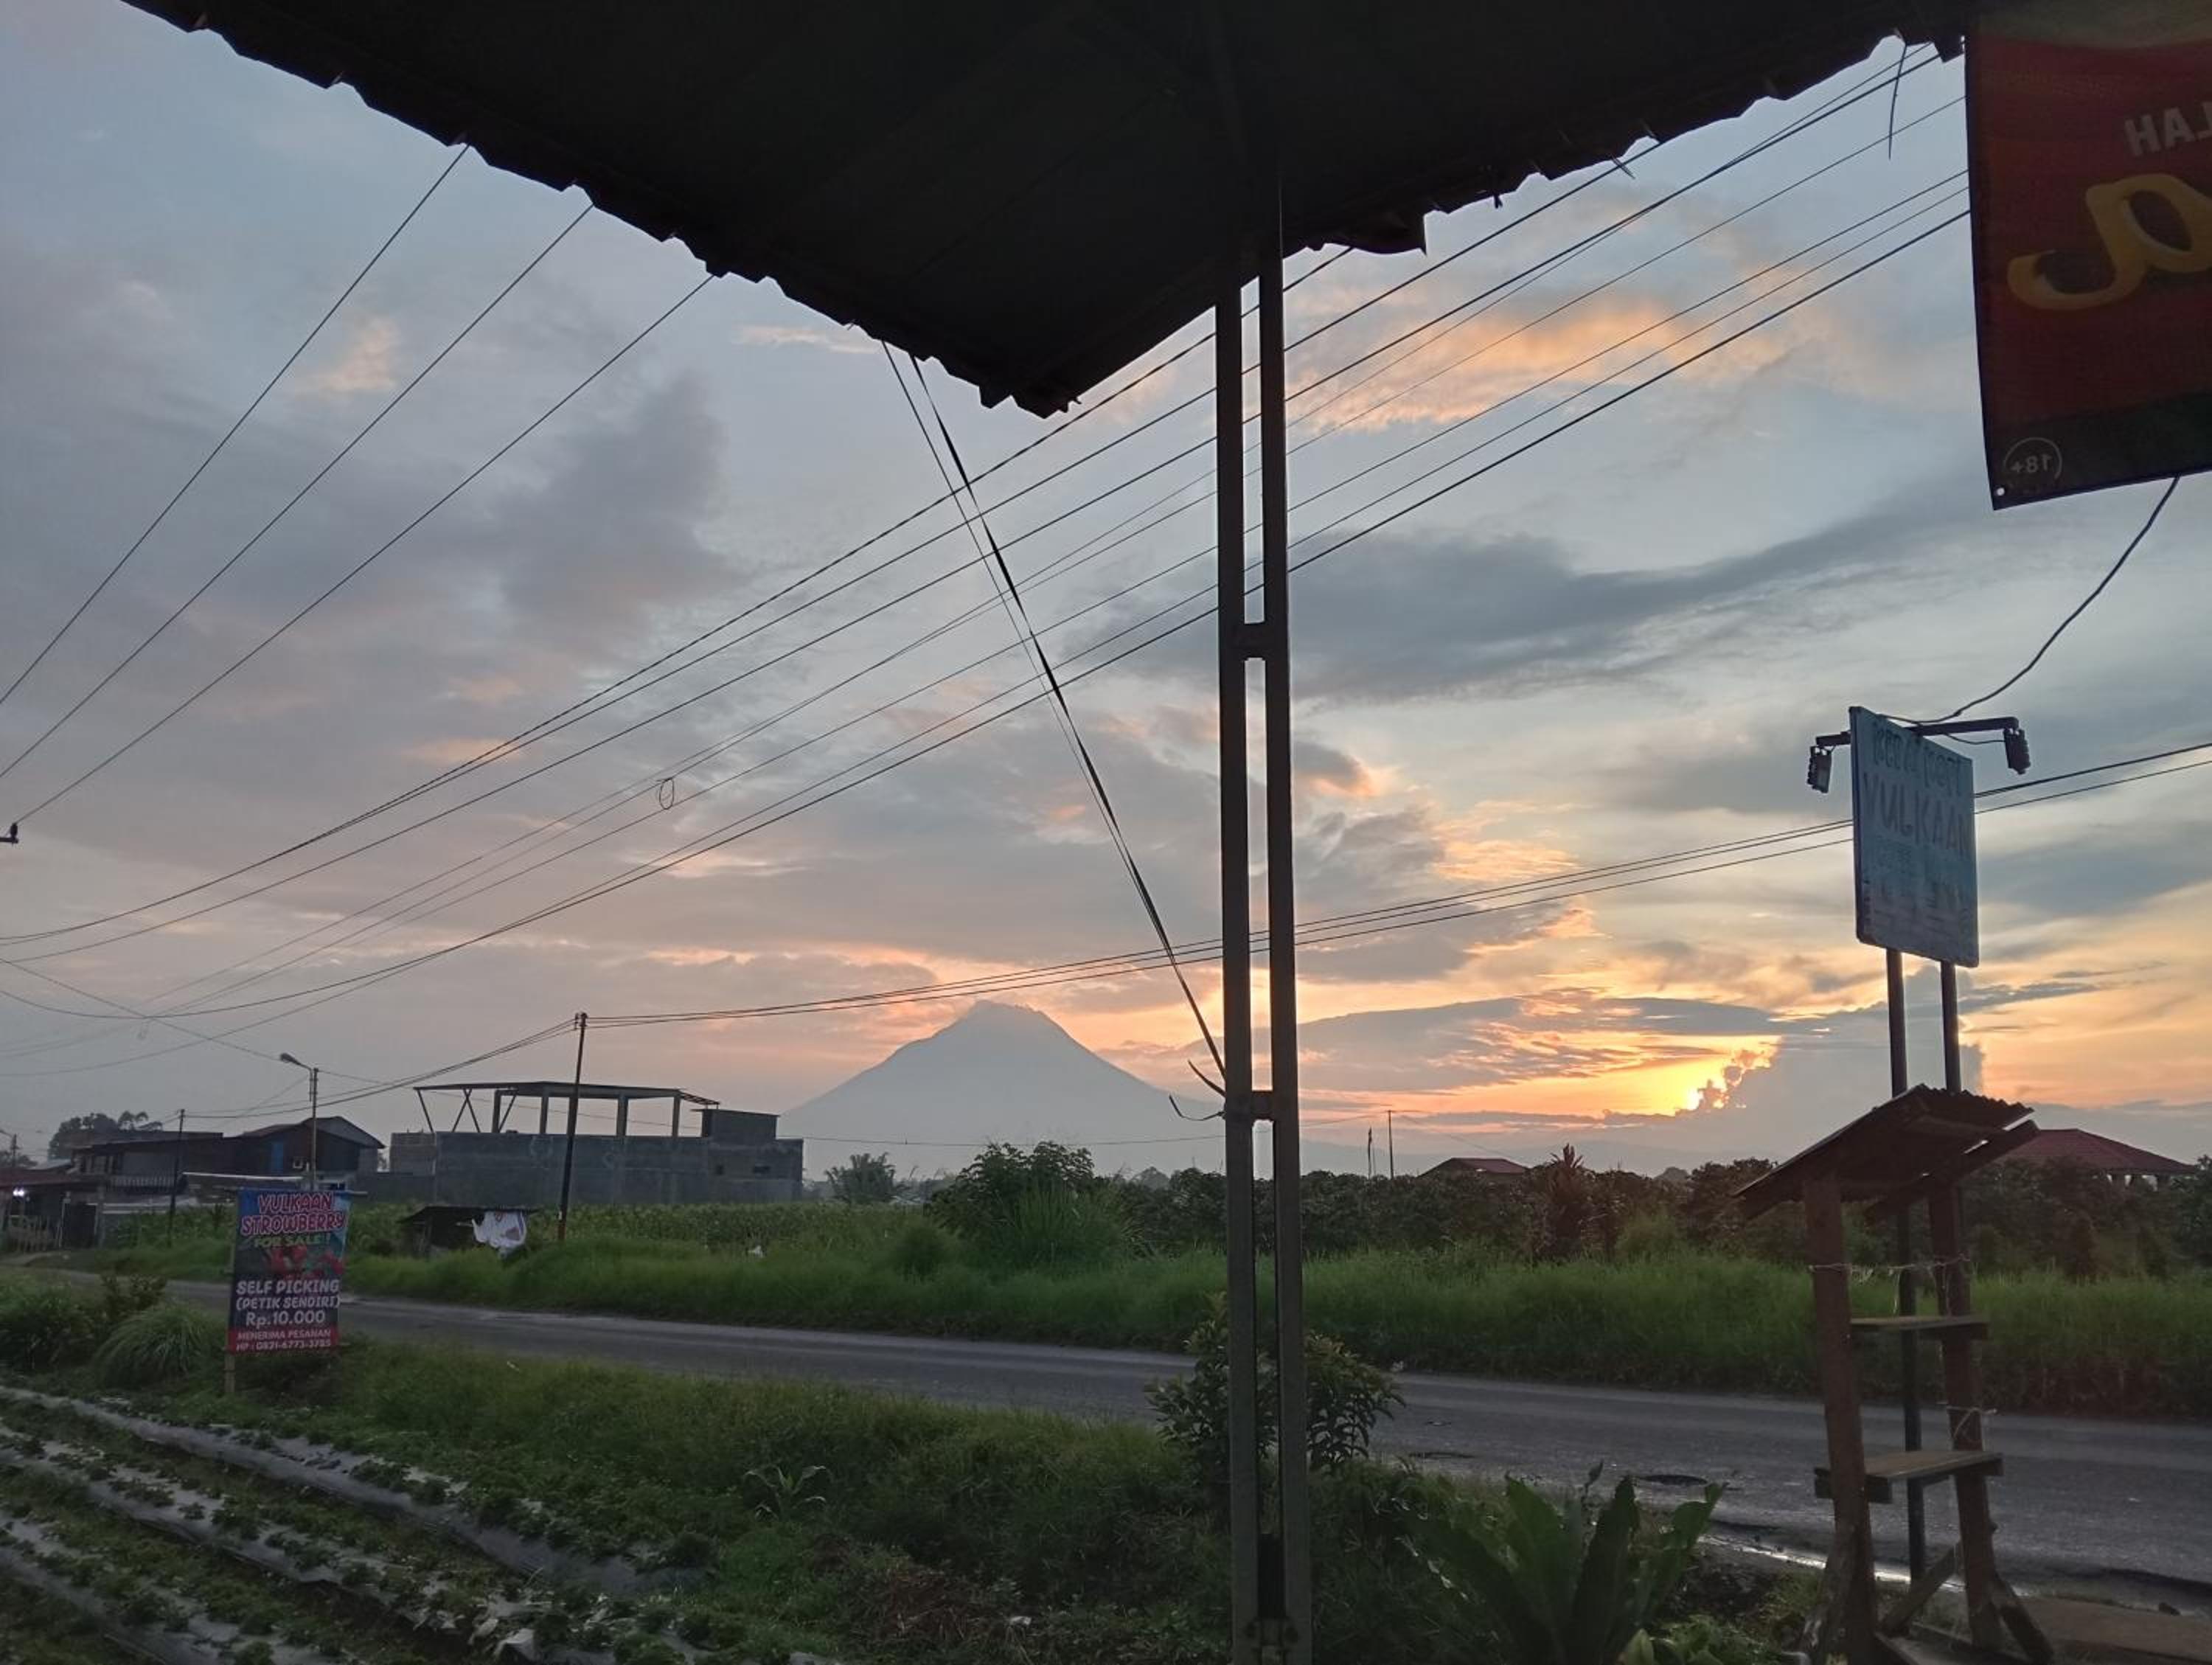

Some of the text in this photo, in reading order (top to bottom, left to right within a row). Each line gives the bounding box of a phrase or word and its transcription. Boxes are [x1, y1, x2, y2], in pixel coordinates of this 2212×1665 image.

[258, 1192, 335, 1214] VULKAAN
[240, 1211, 348, 1236] STROWBERRY
[254, 1232, 331, 1248] FOR SALE!
[236, 1279, 341, 1295] SELF PICKING
[236, 1295, 341, 1310] (PETIK SENDIRI)
[246, 1310, 325, 1329] Rp.10.000
[237, 1328, 331, 1341] MENERIMA PESANAN
